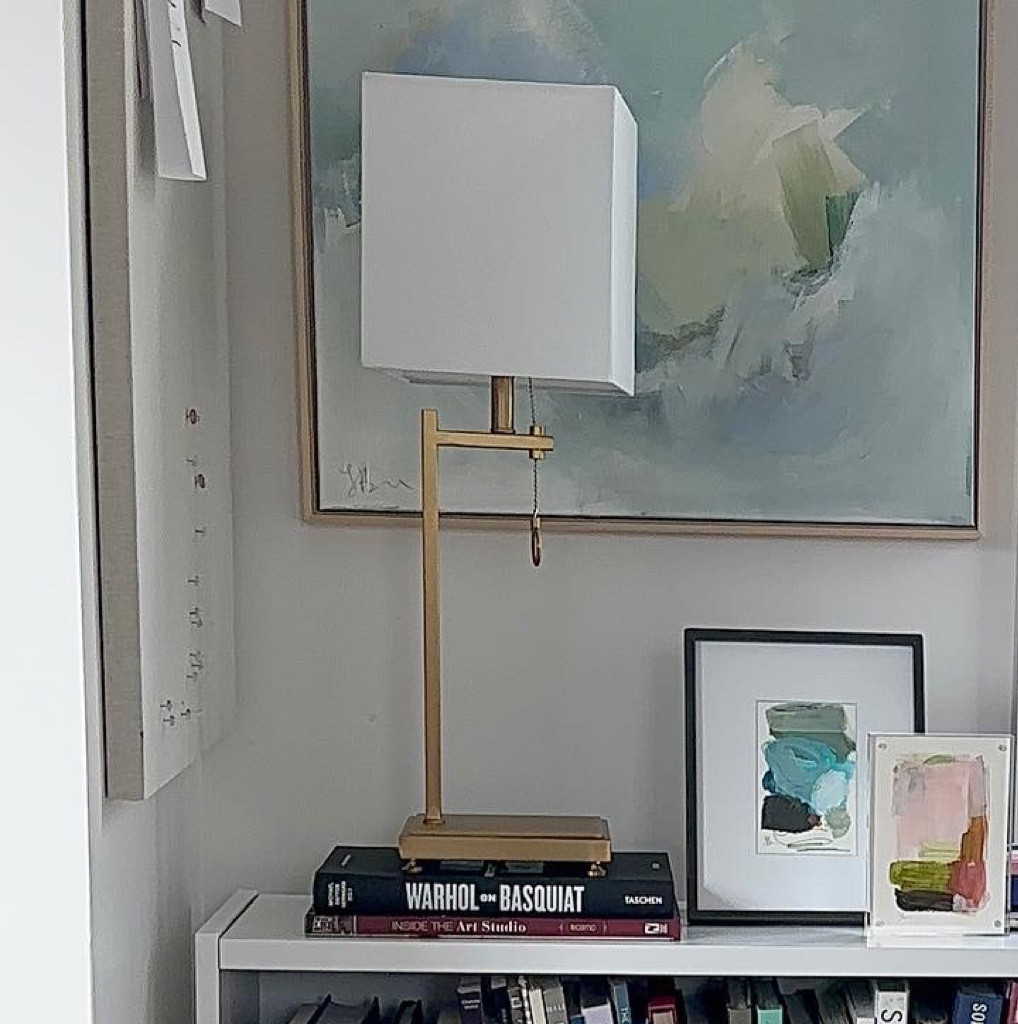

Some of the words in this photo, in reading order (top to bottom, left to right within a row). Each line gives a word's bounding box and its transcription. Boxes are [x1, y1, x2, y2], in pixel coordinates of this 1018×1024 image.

[405, 882, 479, 911] WARHOL
[500, 884, 585, 913] BASQUIAT
[624, 895, 662, 905] TASCHEN
[391, 921, 428, 930] INSIDE
[431, 921, 453, 930] THE
[457, 921, 477, 932] Art
[481, 921, 526, 932] Studio
[620, 1007, 630, 1023] THE
